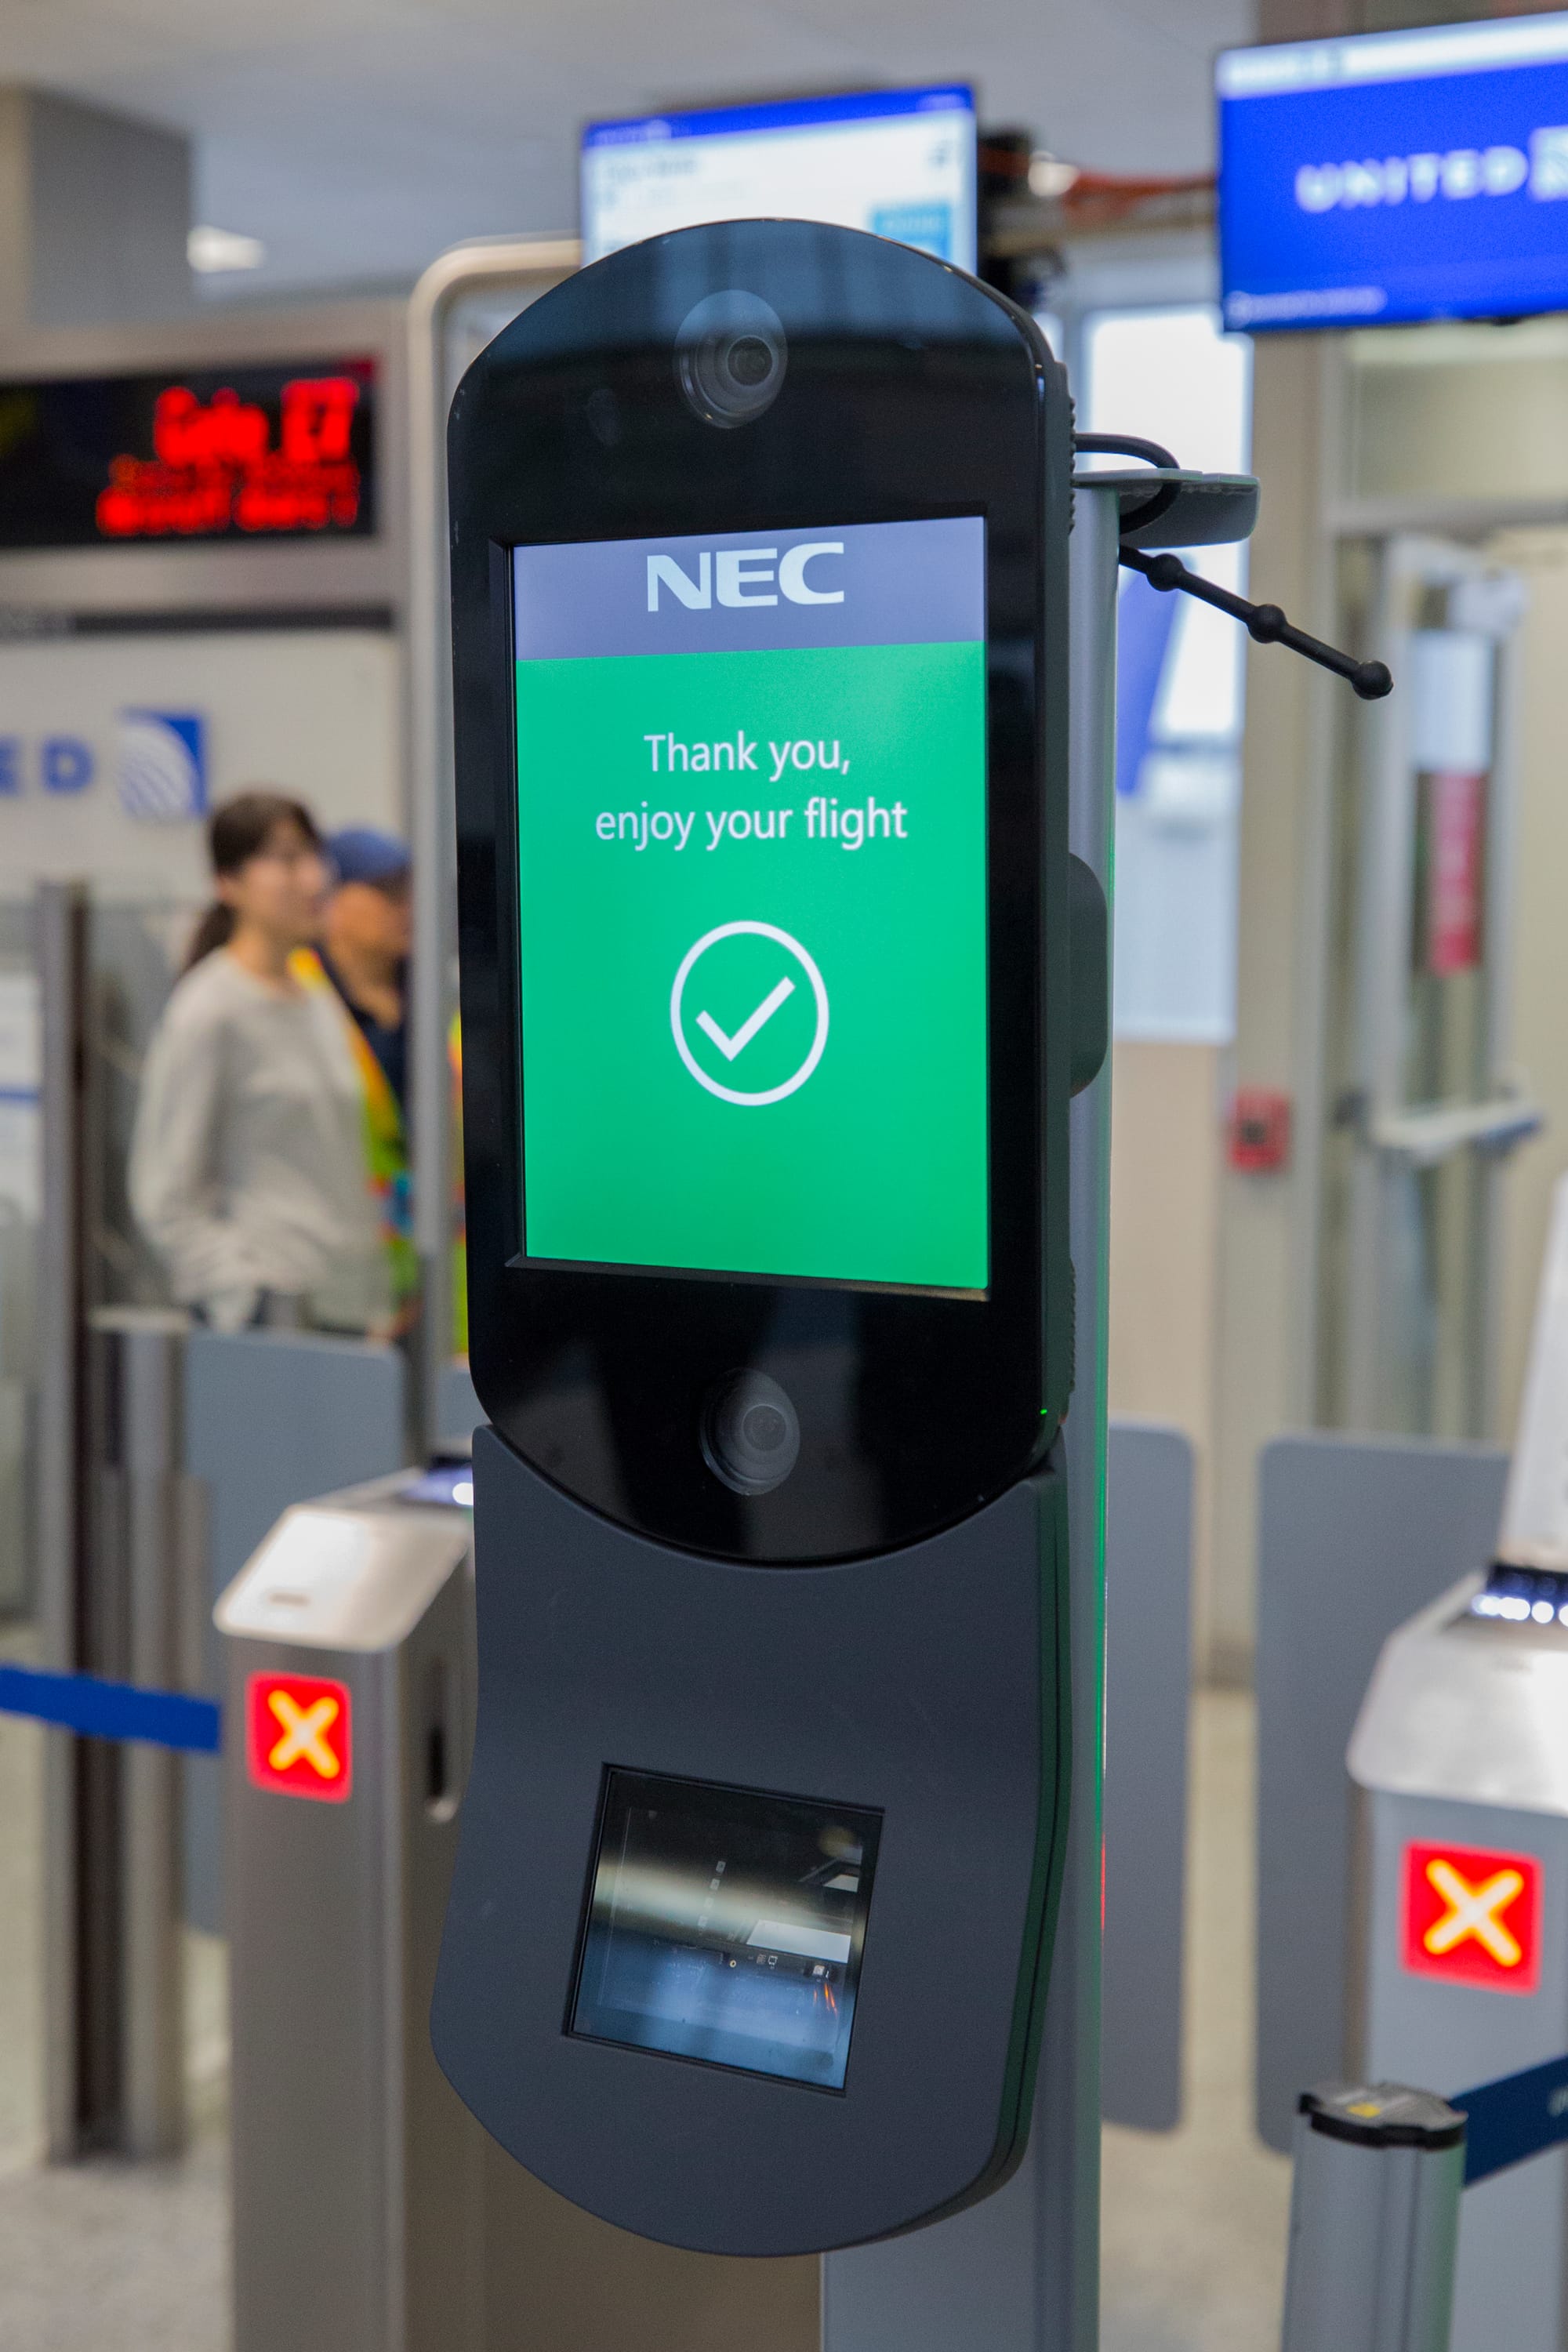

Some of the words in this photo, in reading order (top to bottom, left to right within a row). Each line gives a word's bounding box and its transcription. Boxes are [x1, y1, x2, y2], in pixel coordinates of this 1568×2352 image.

[1294, 146, 1528, 214] UNITED
[647, 542, 845, 612] NEC
[643, 730, 759, 773] Thank
[768, 739, 851, 782] you,
[595, 800, 696, 851] enjoy
[705, 809, 793, 851] your
[804, 796, 909, 851] flight
